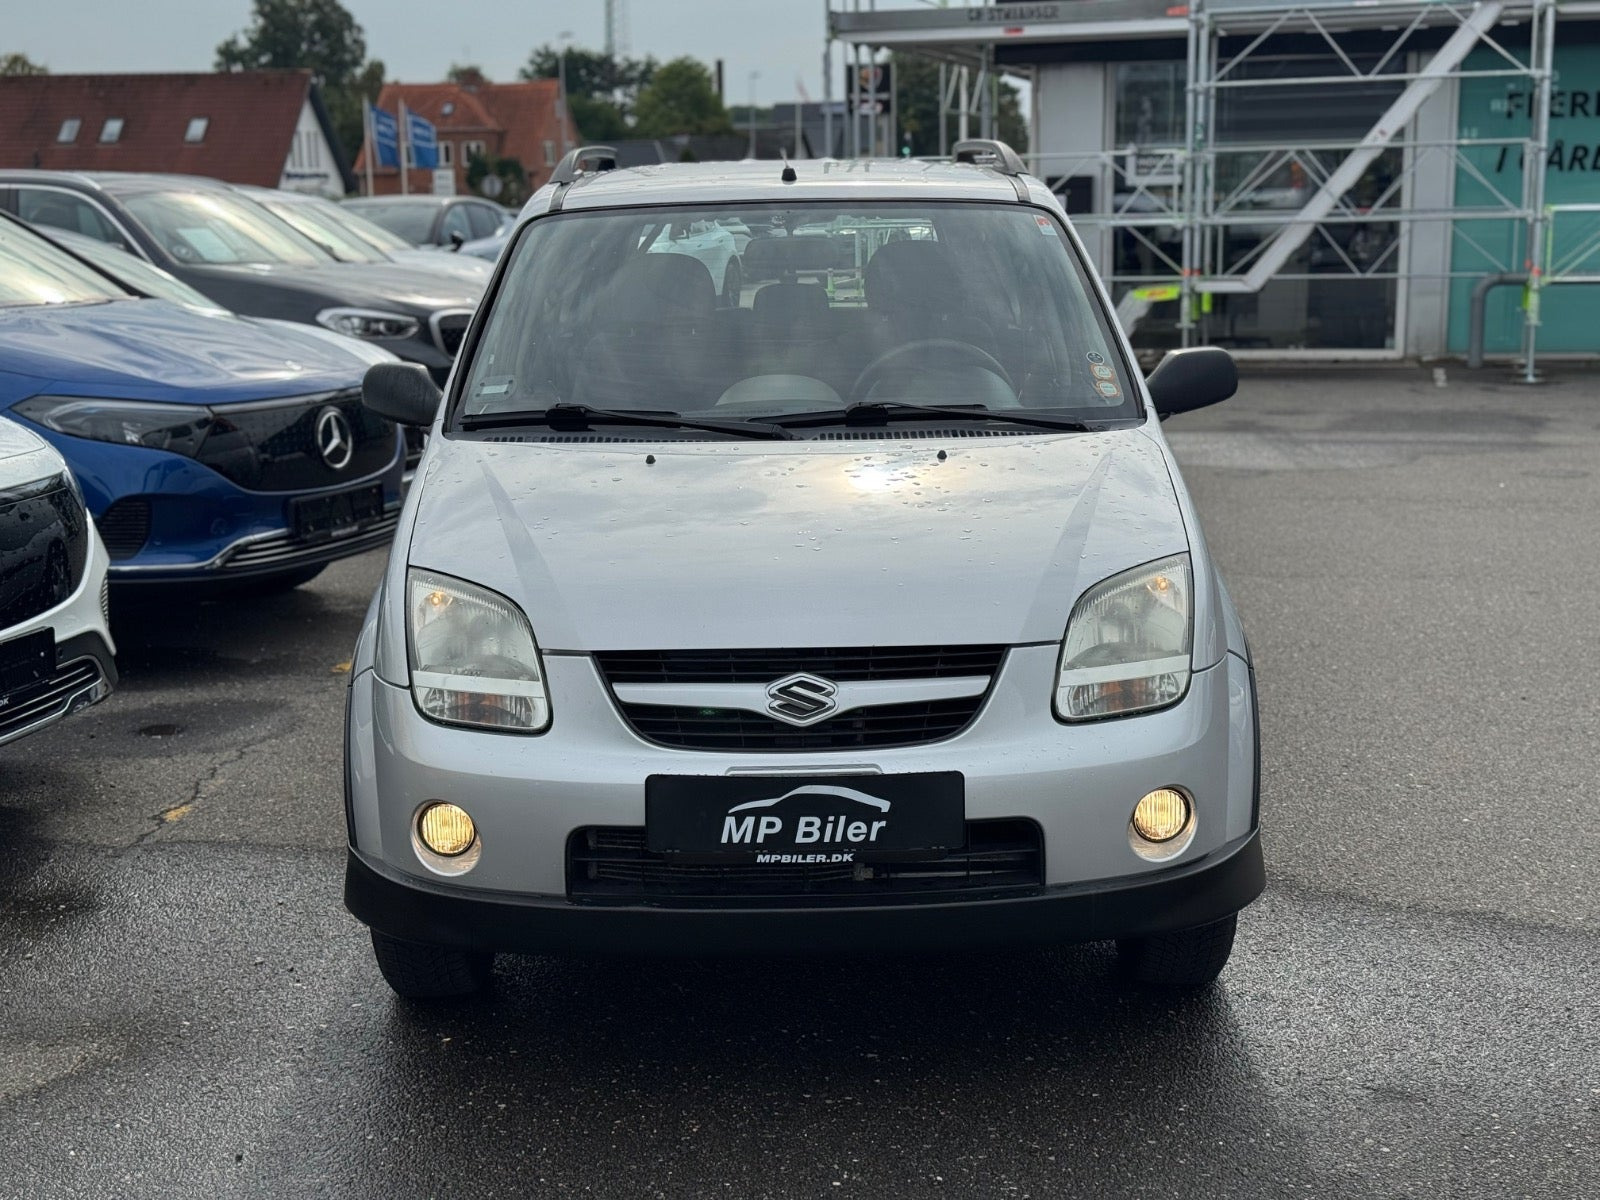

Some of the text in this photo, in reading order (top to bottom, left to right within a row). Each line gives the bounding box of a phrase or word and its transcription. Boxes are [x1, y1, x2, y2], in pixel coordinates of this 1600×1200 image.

[720, 815, 887, 844] MP Biler
[756, 853, 854, 863] MPBILER.DK
